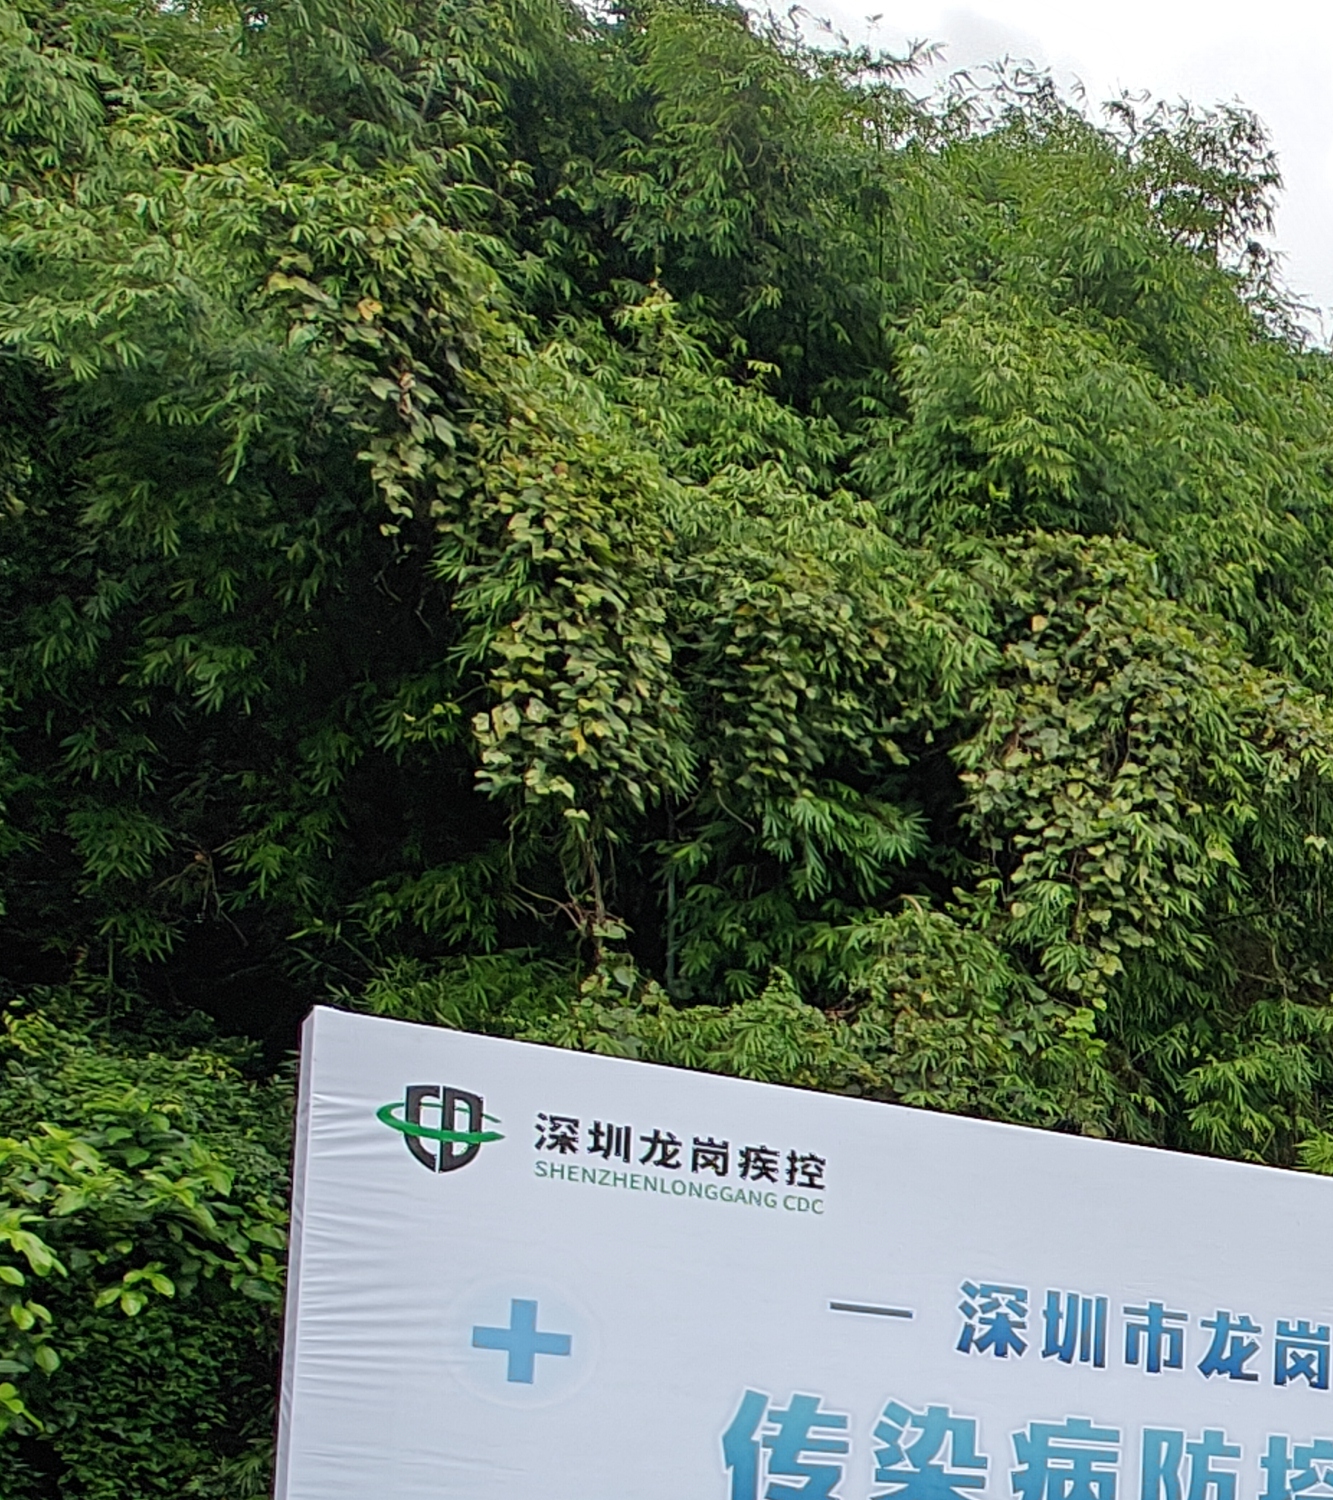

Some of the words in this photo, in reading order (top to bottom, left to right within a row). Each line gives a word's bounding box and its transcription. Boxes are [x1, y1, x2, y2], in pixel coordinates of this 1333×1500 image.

[534, 1111, 828, 1190] 深圳龙岗疾控
[534, 1160, 778, 1209] SHENZHENLONGGANG
[783, 1194, 826, 1216] CDC
